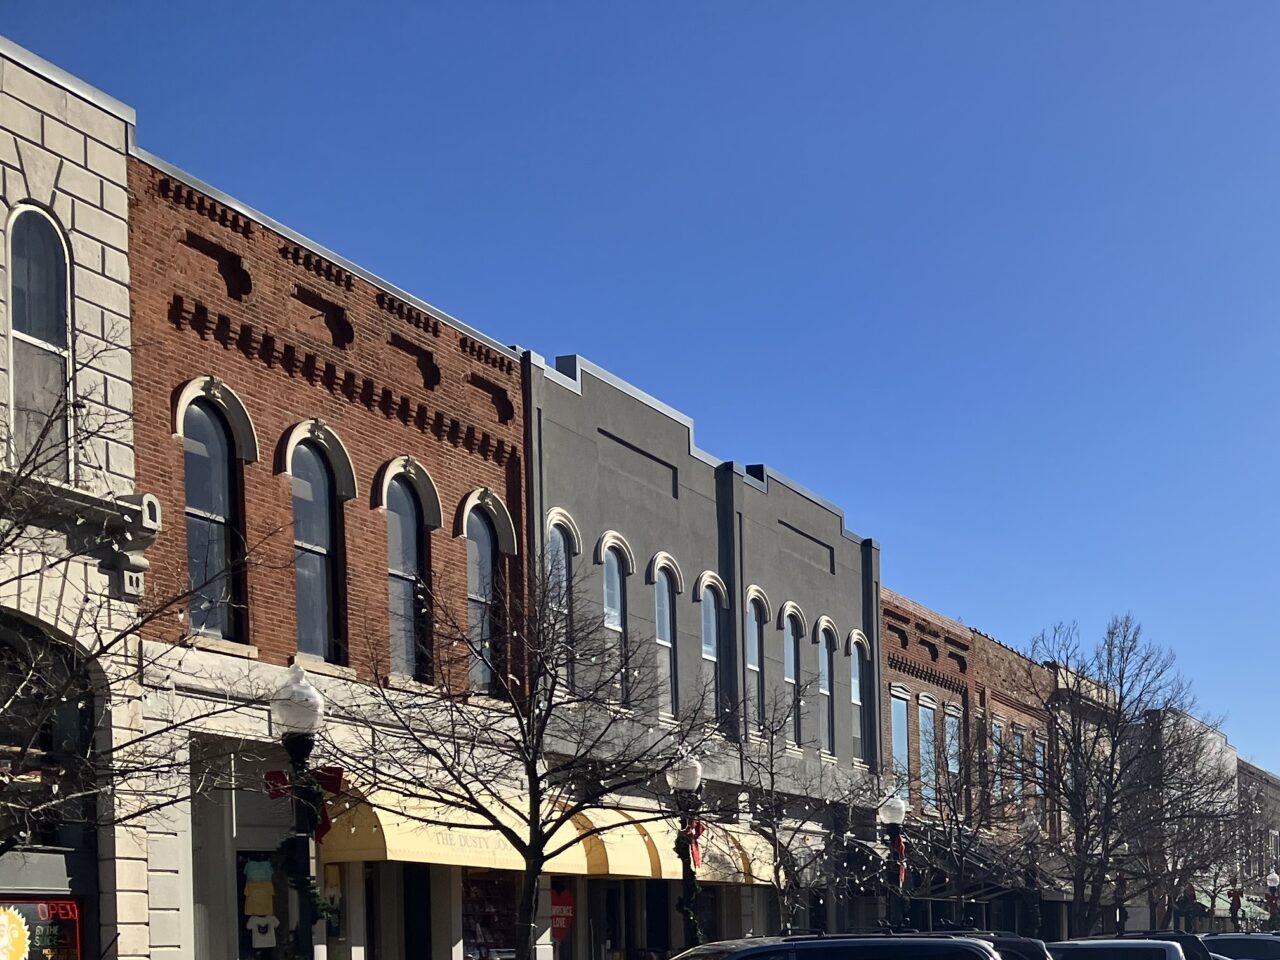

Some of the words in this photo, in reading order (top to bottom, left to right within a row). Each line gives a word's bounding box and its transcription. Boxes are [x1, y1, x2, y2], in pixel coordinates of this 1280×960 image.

[435, 832, 456, 846] THE
[458, 834, 489, 849] DUSTY
[38, 903, 78, 920] OPEN
[552, 905, 574, 917] WRENCE
